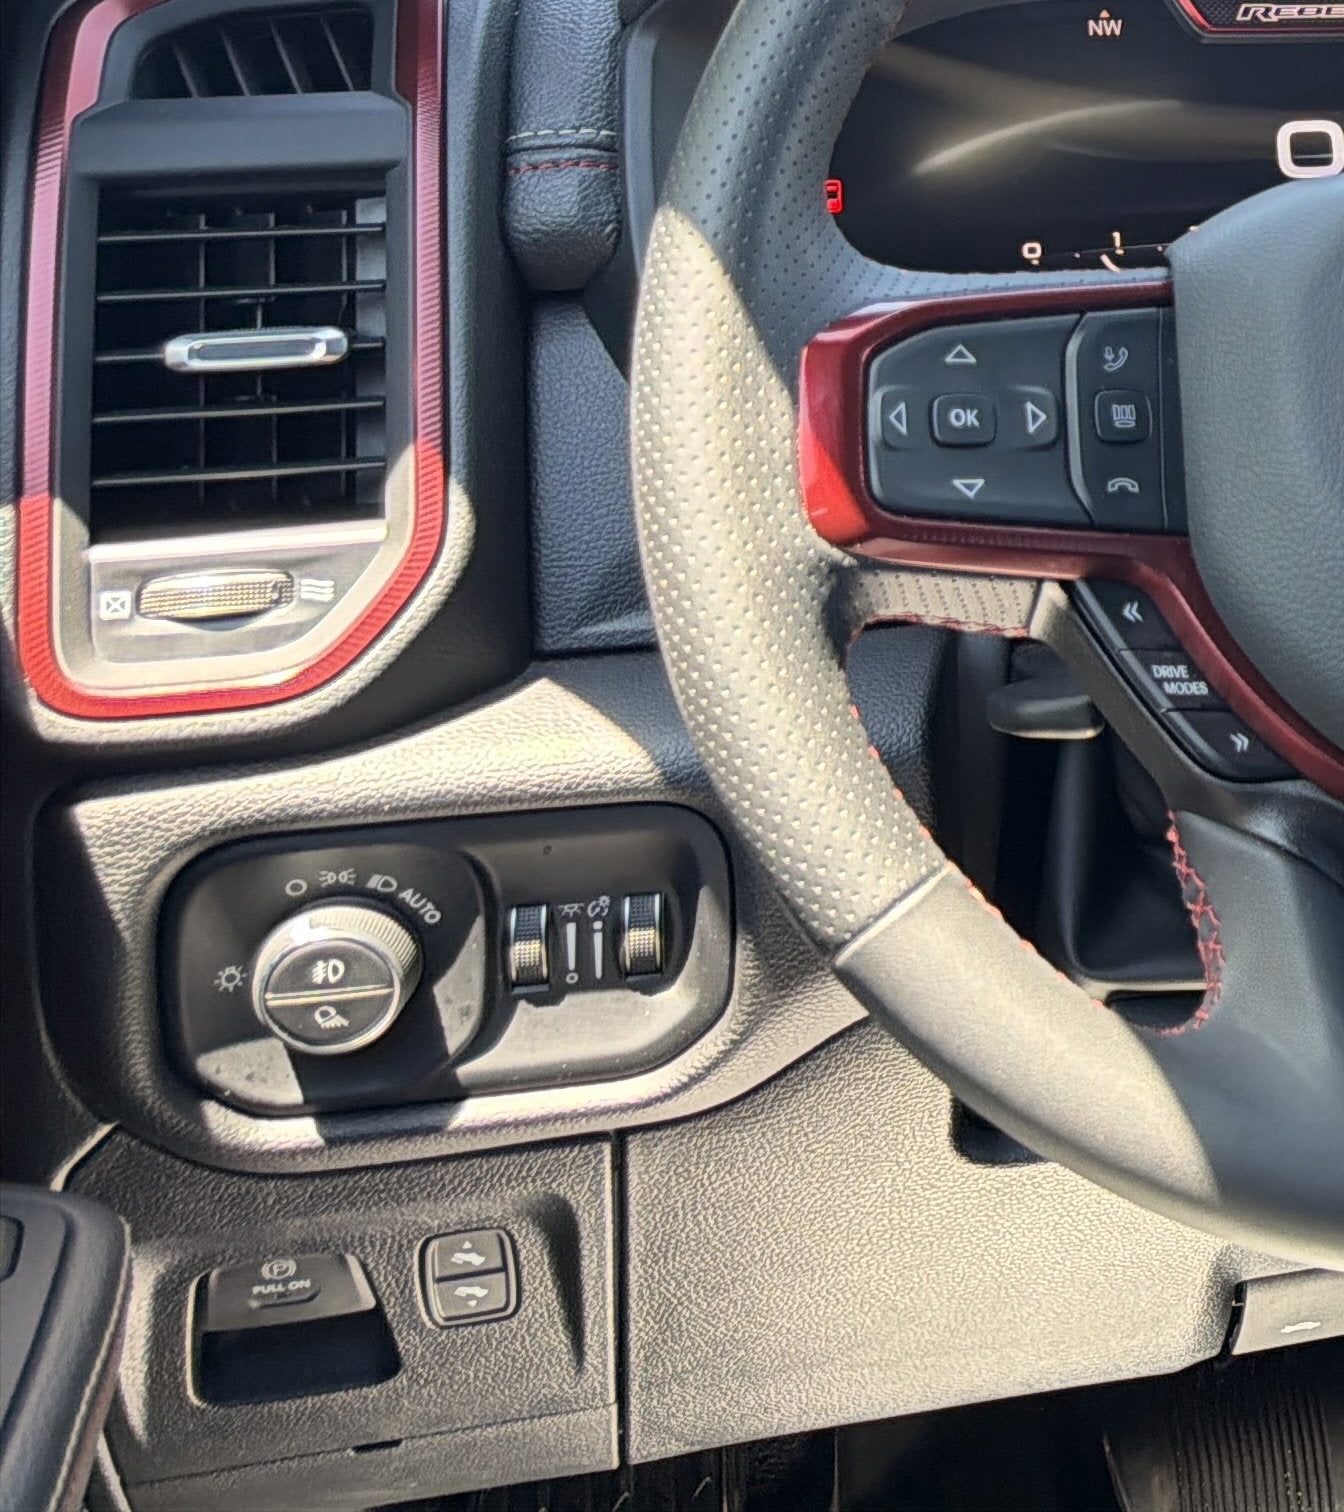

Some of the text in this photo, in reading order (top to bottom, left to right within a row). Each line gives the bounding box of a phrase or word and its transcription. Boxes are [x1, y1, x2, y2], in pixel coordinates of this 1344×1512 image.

[1088, 18, 1123, 37] NW
[950, 407, 980, 428] OK
[1151, 664, 1189, 679] DRIVE
[1163, 680, 1209, 696] MODES
[398, 888, 442, 924] AUTO
[252, 1278, 312, 1295] PULL ON
